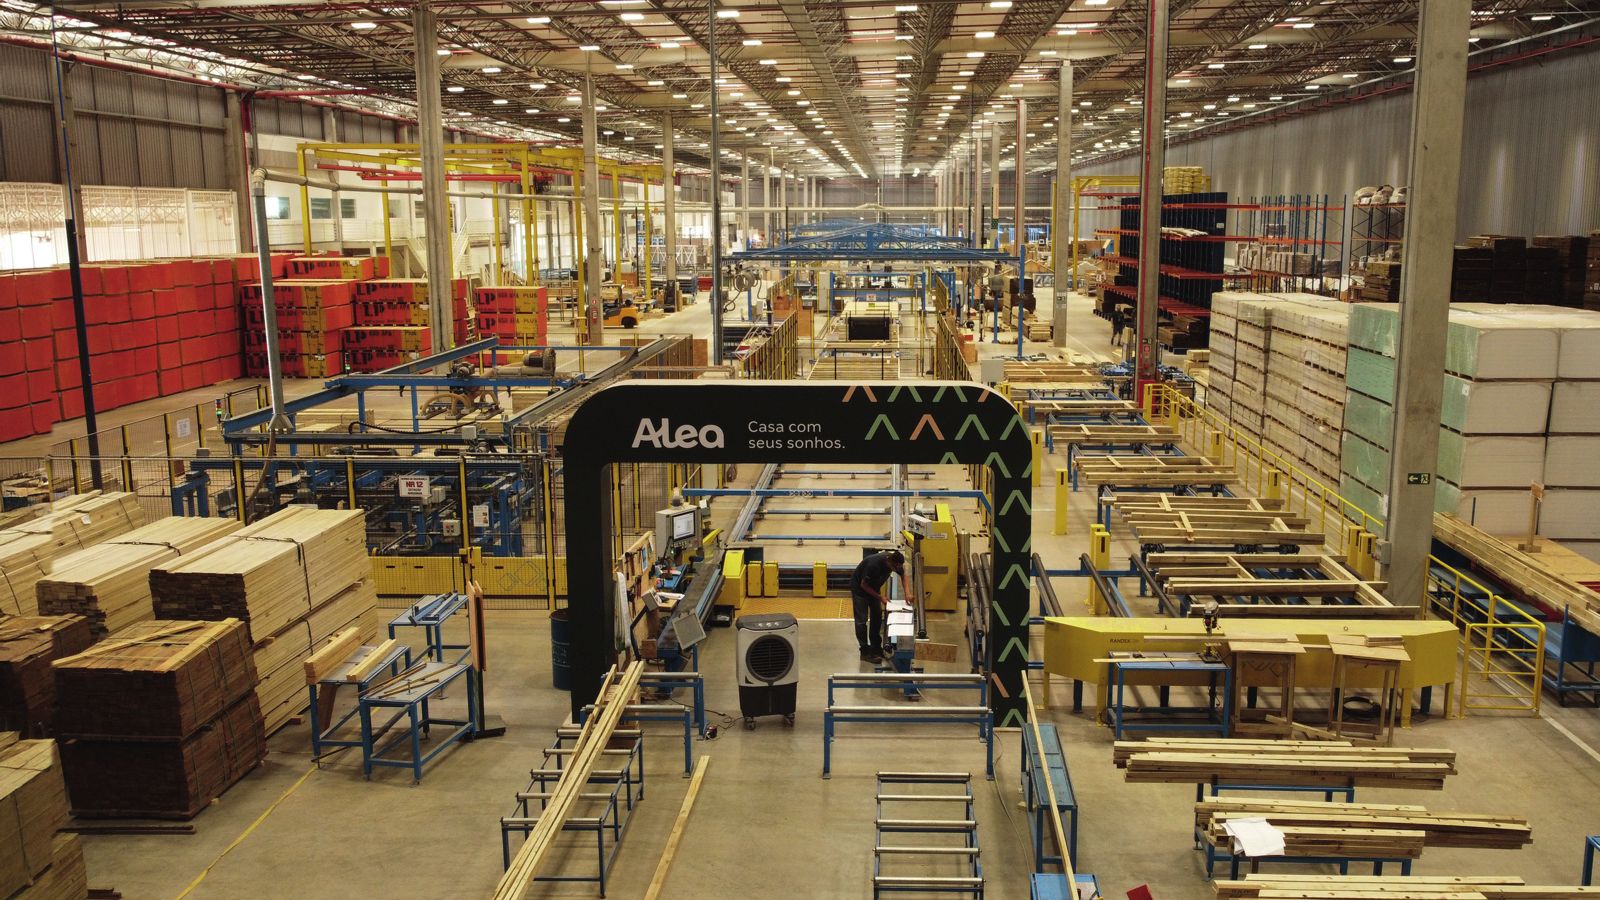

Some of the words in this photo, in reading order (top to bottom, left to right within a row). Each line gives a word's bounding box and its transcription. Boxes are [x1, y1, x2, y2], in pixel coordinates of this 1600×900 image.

[356, 283, 377, 295] LP
[475, 293, 495, 304] LP
[363, 303, 385, 317] LP
[478, 318, 496, 330] LP
[344, 329, 367, 343] LP
[631, 417, 725, 449] Alea
[747, 420, 784, 433] Casa
[788, 421, 822, 433] com
[748, 437, 783, 449] seus
[786, 435, 846, 449] sonhos.
